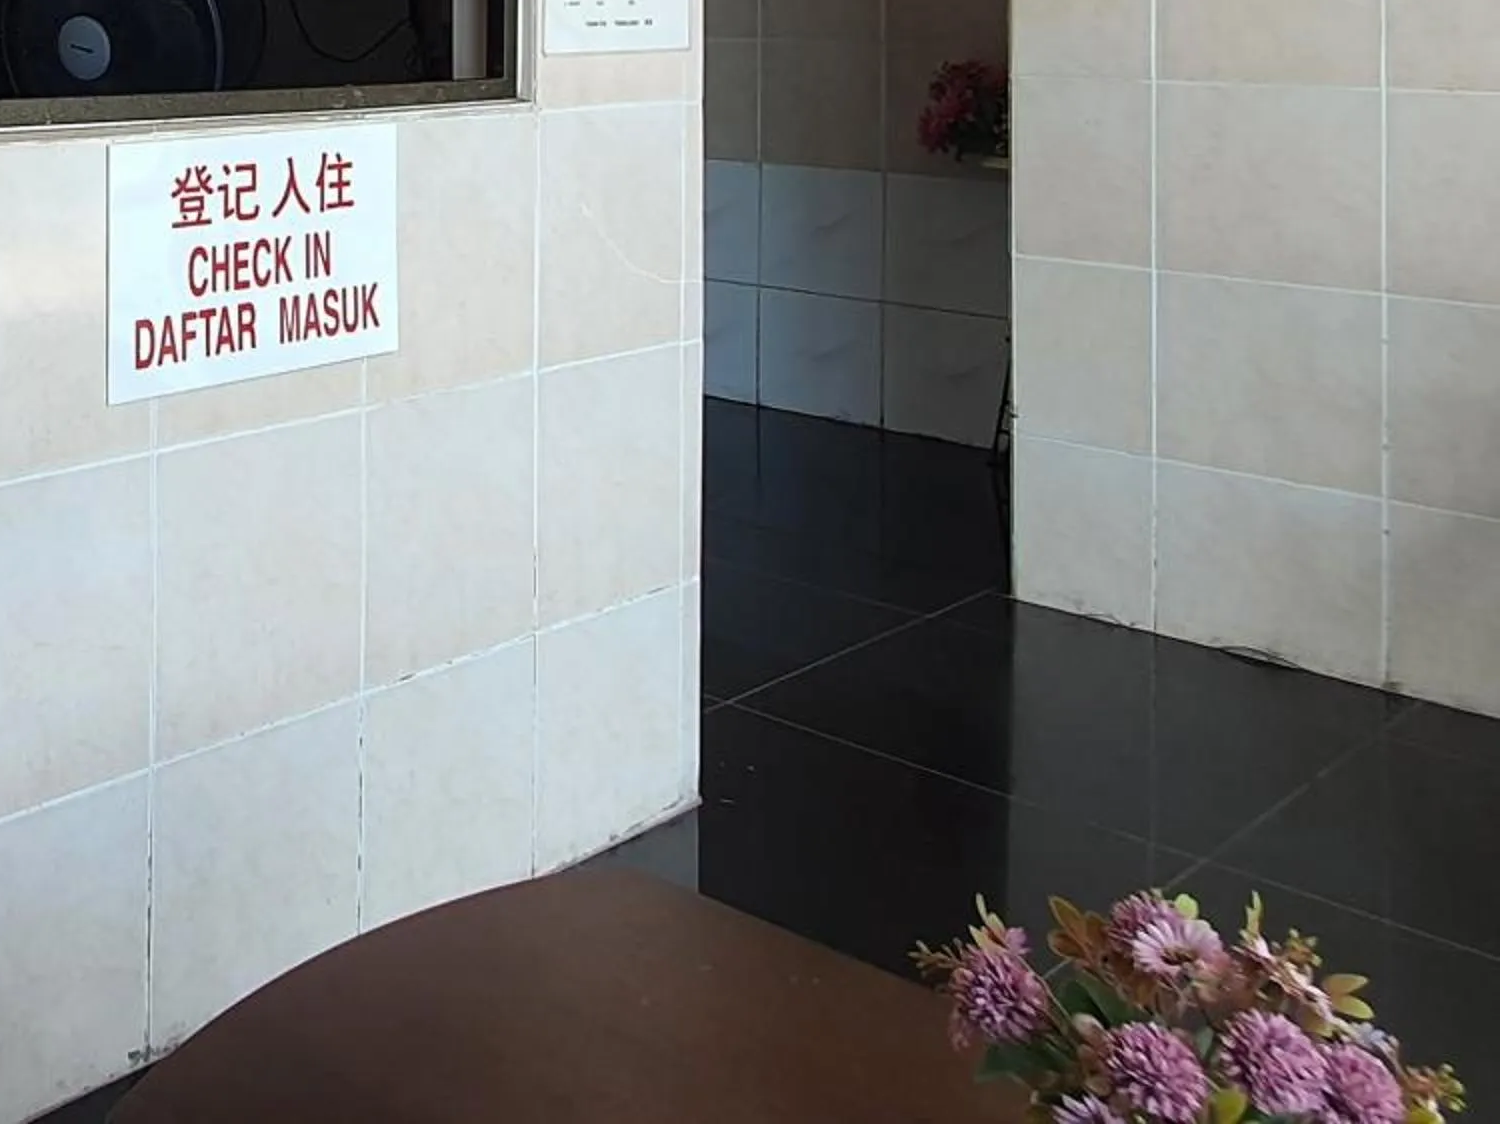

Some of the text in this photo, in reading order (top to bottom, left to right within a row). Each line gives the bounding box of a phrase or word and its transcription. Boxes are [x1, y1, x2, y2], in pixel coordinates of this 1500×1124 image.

[171, 152, 355, 228] 登记入住
[188, 231, 330, 297] CHECK IN
[136, 282, 380, 369] DAFTAR MASUK
